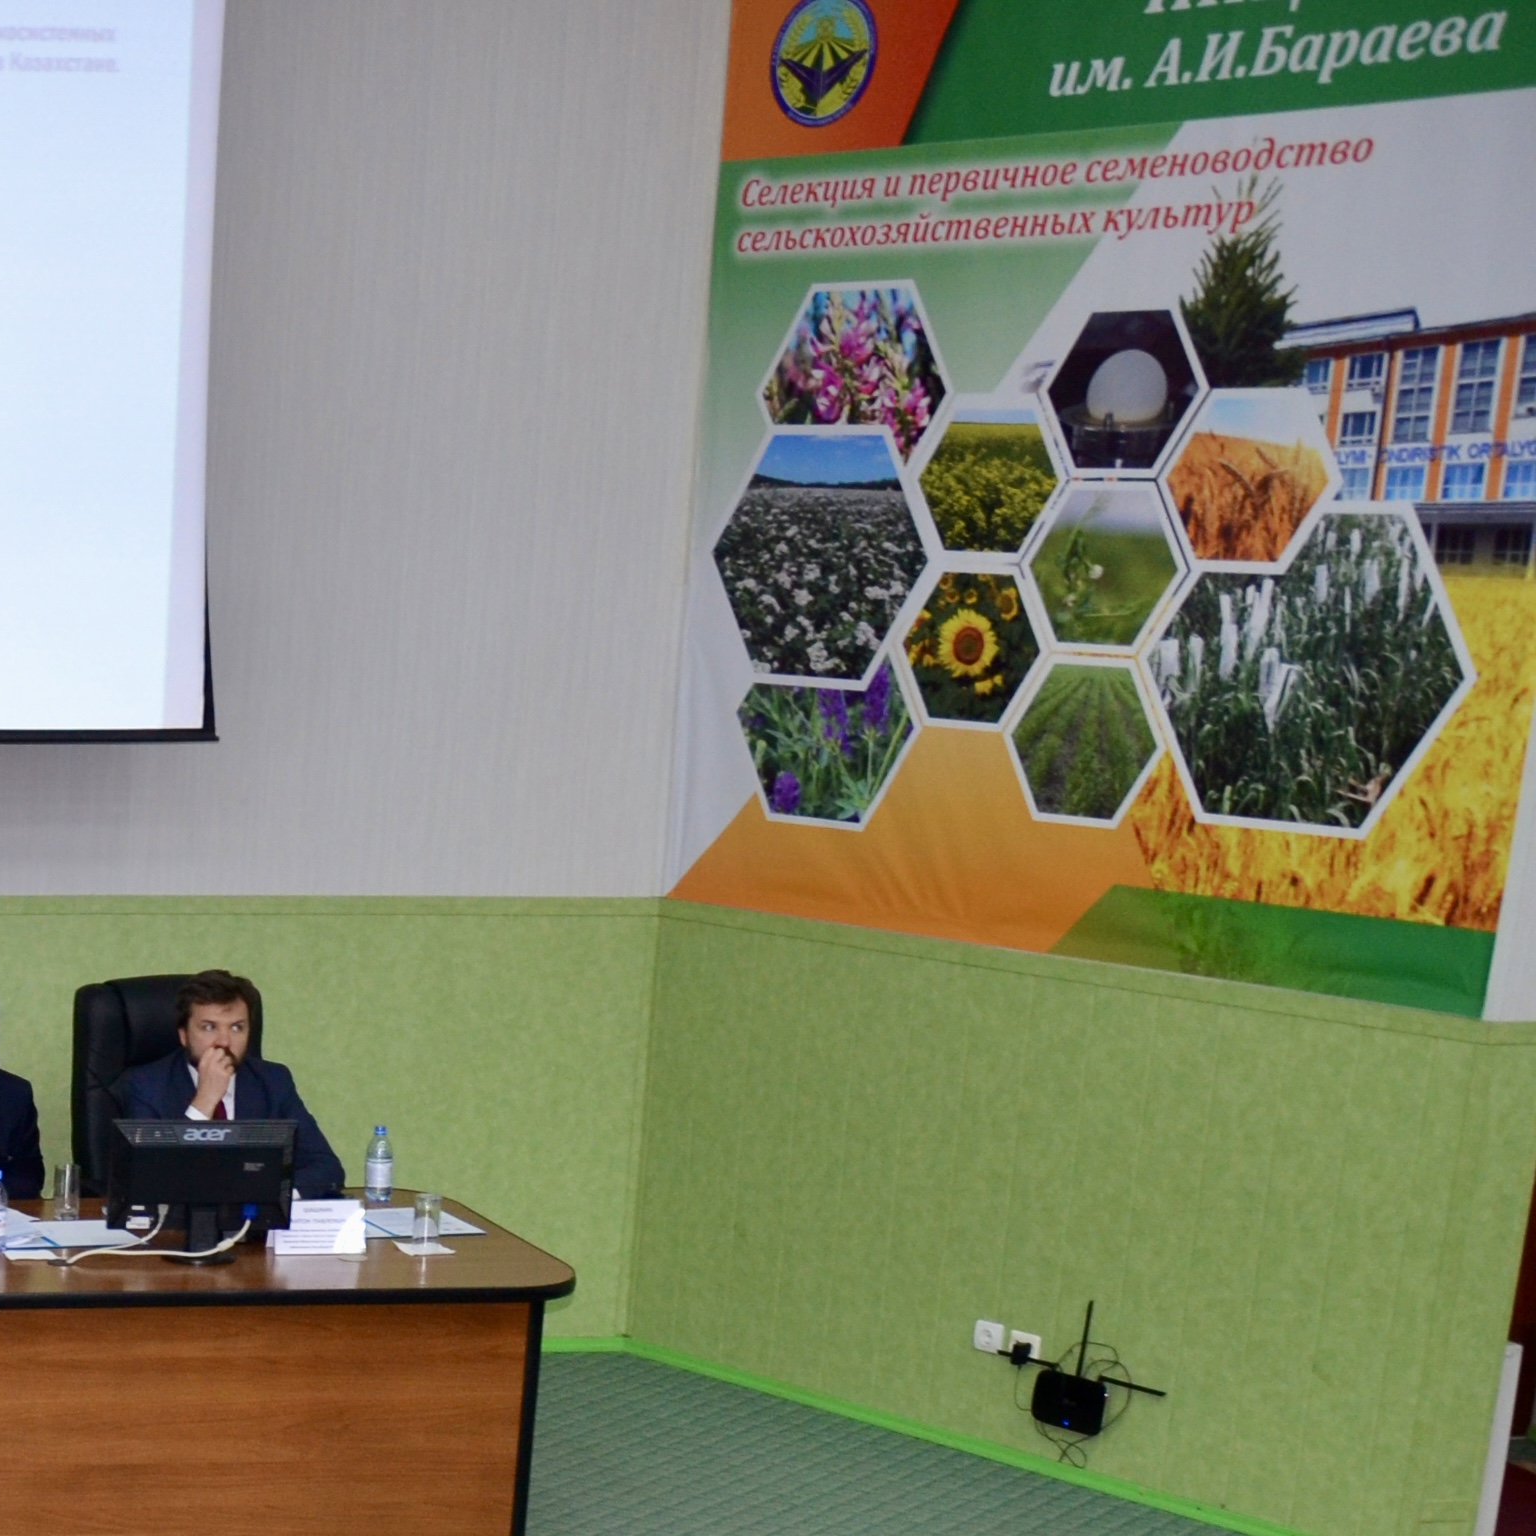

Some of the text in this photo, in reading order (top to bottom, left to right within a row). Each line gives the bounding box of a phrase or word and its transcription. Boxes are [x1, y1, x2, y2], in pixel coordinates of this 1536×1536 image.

[1049, 10, 1508, 97] им. А.И.Бараева
[741, 136, 1374, 208] Селекция и первичное семеноводство
[736, 199, 1255, 253] сельскохозяйственных культур
[183, 1128, 231, 1141] acer
